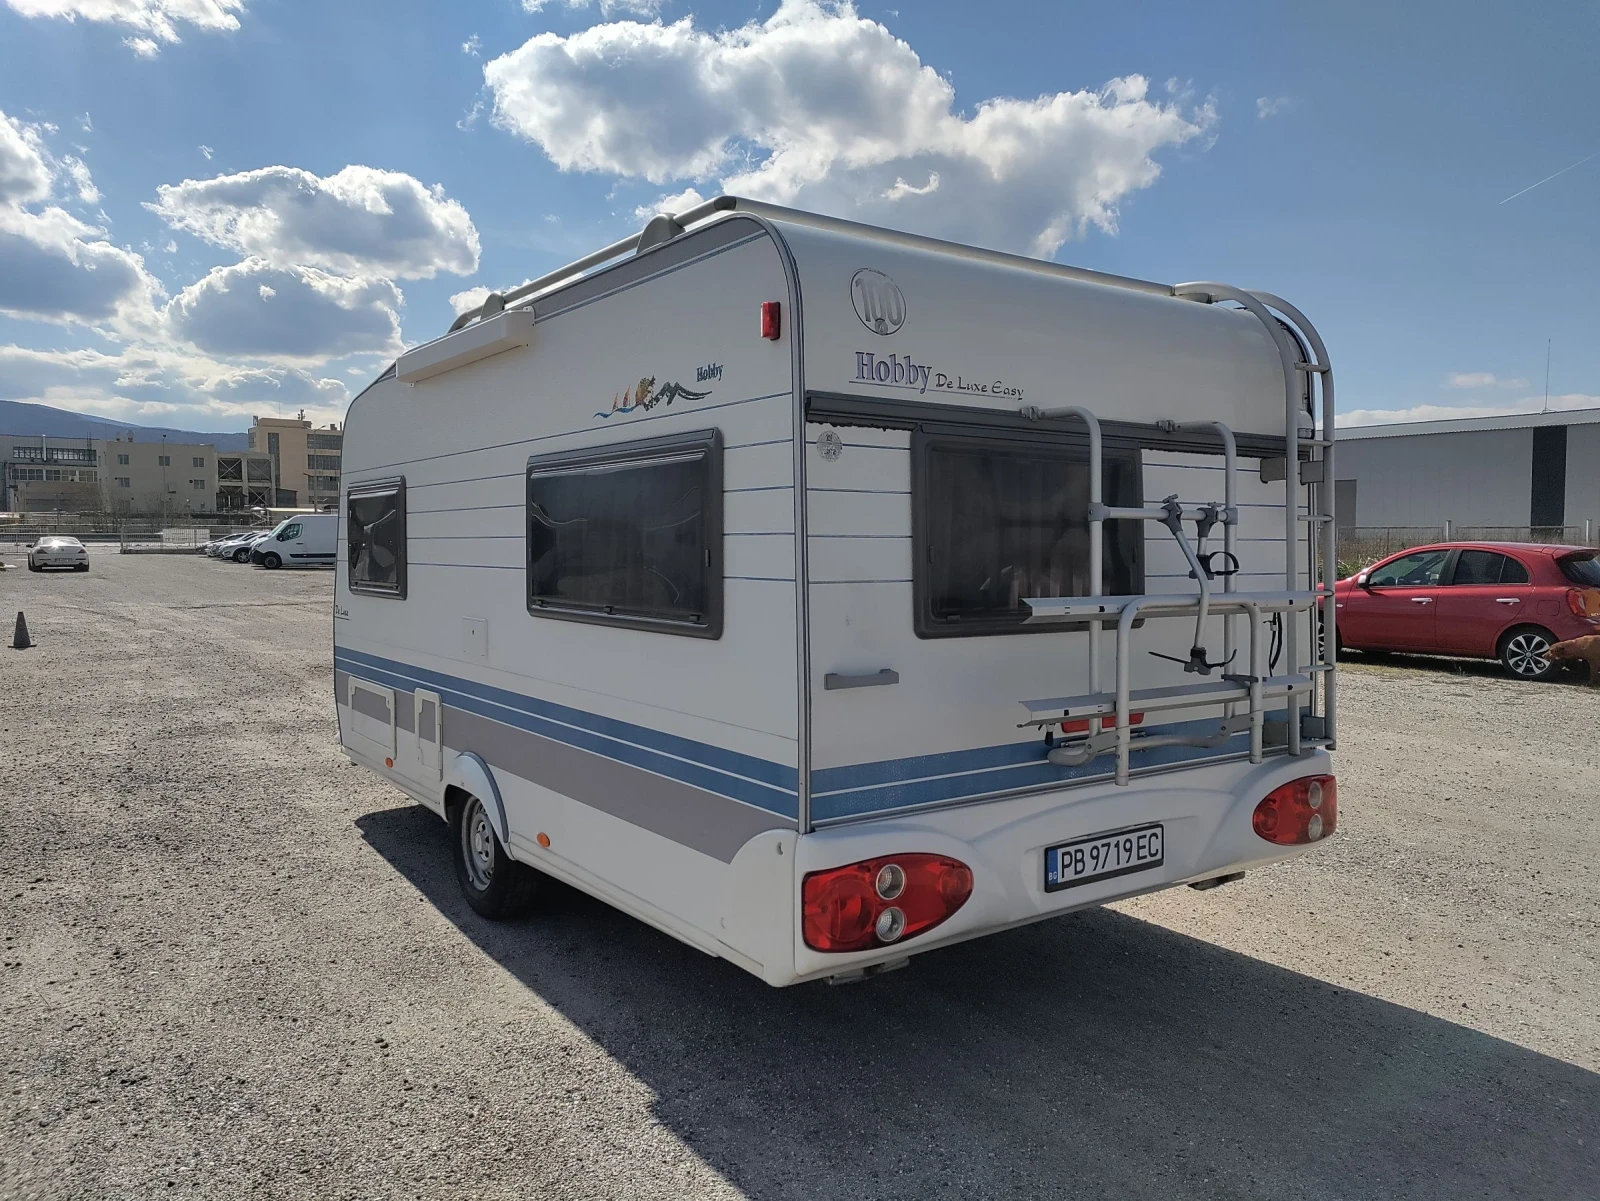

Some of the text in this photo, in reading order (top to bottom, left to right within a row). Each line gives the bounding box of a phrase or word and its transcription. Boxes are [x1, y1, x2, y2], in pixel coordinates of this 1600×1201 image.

[696, 362, 724, 382] Hobby
[855, 352, 1024, 400] Hobby De Luxe Easy
[1061, 832, 1159, 878] PB 9719 EC
[1048, 871, 1058, 880] BG
